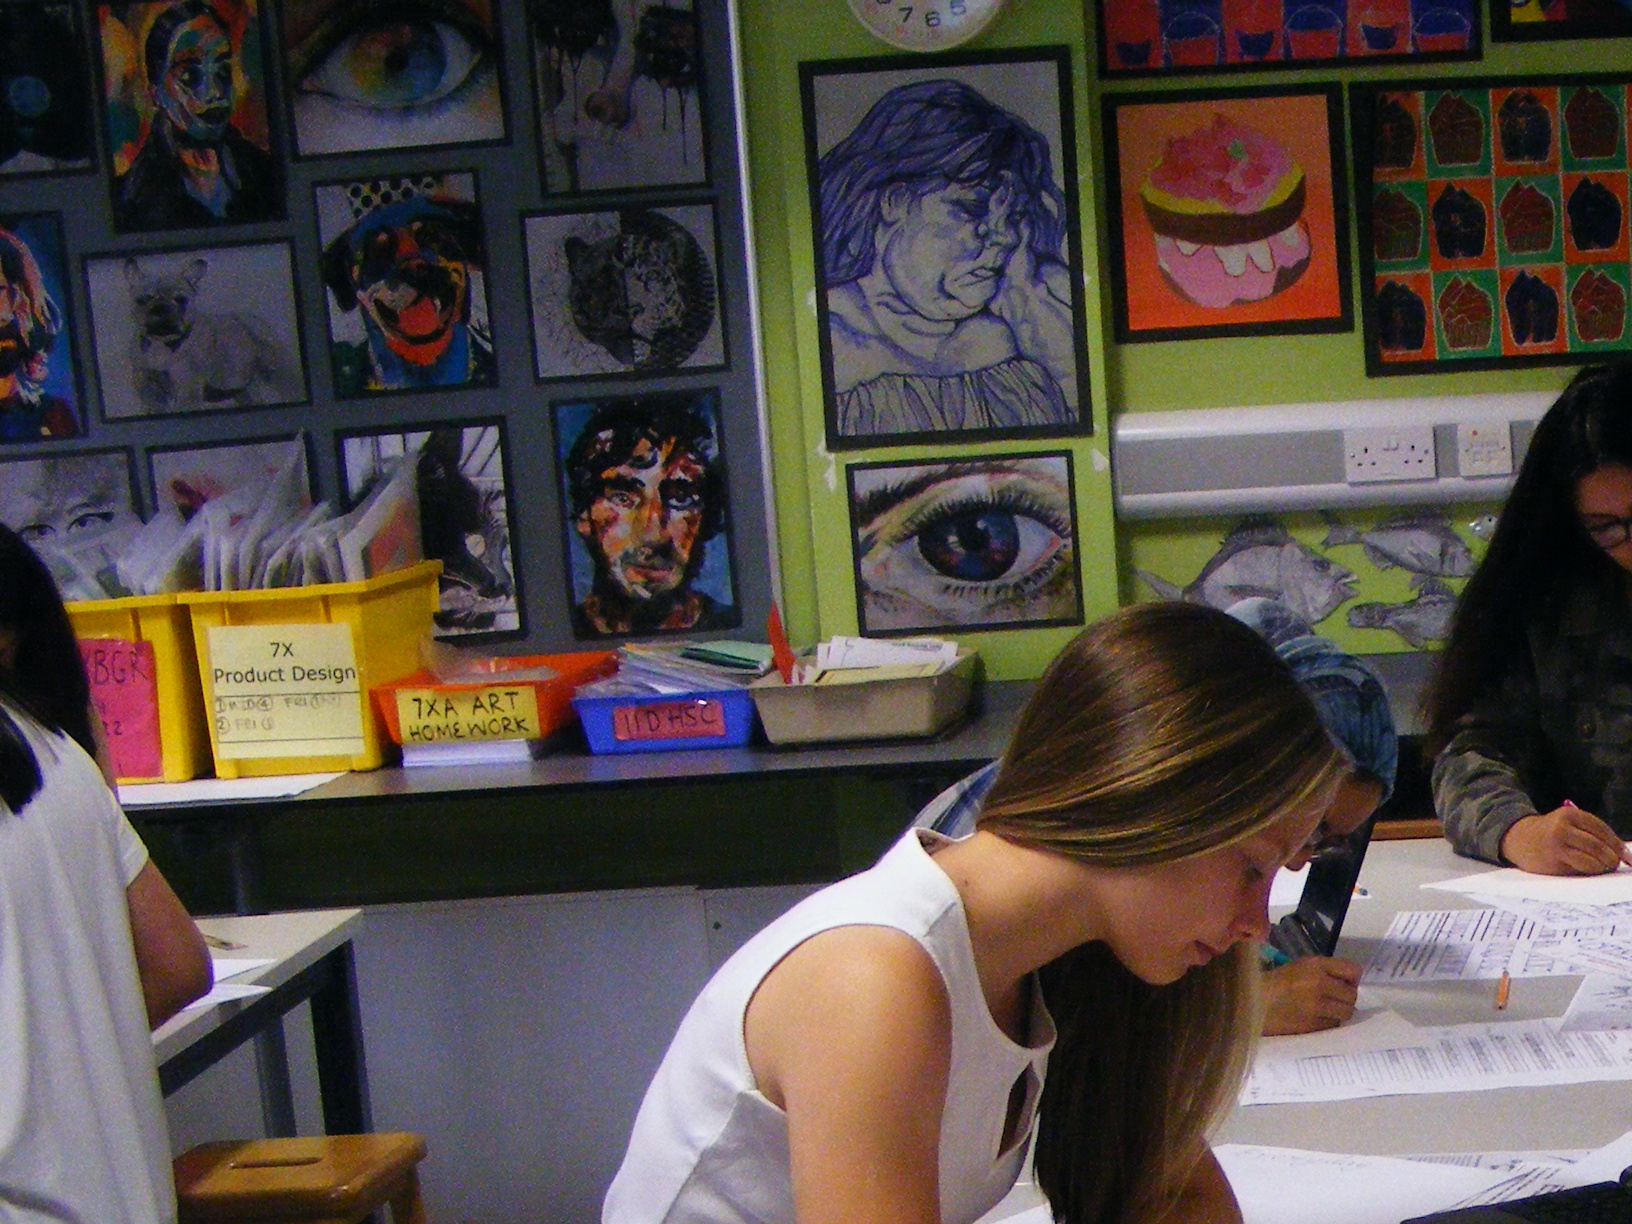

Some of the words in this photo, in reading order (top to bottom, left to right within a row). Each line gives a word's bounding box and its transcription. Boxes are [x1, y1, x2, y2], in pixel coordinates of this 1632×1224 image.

[899, 6, 914, 23] 7
[924, 10, 942, 28] 6
[270, 641, 295, 659] 7X
[213, 666, 286, 685] Product
[292, 664, 356, 684] Design
[411, 696, 460, 720] 7XA
[471, 690, 521, 717] ART
[408, 716, 532, 743] HOMEWORK
